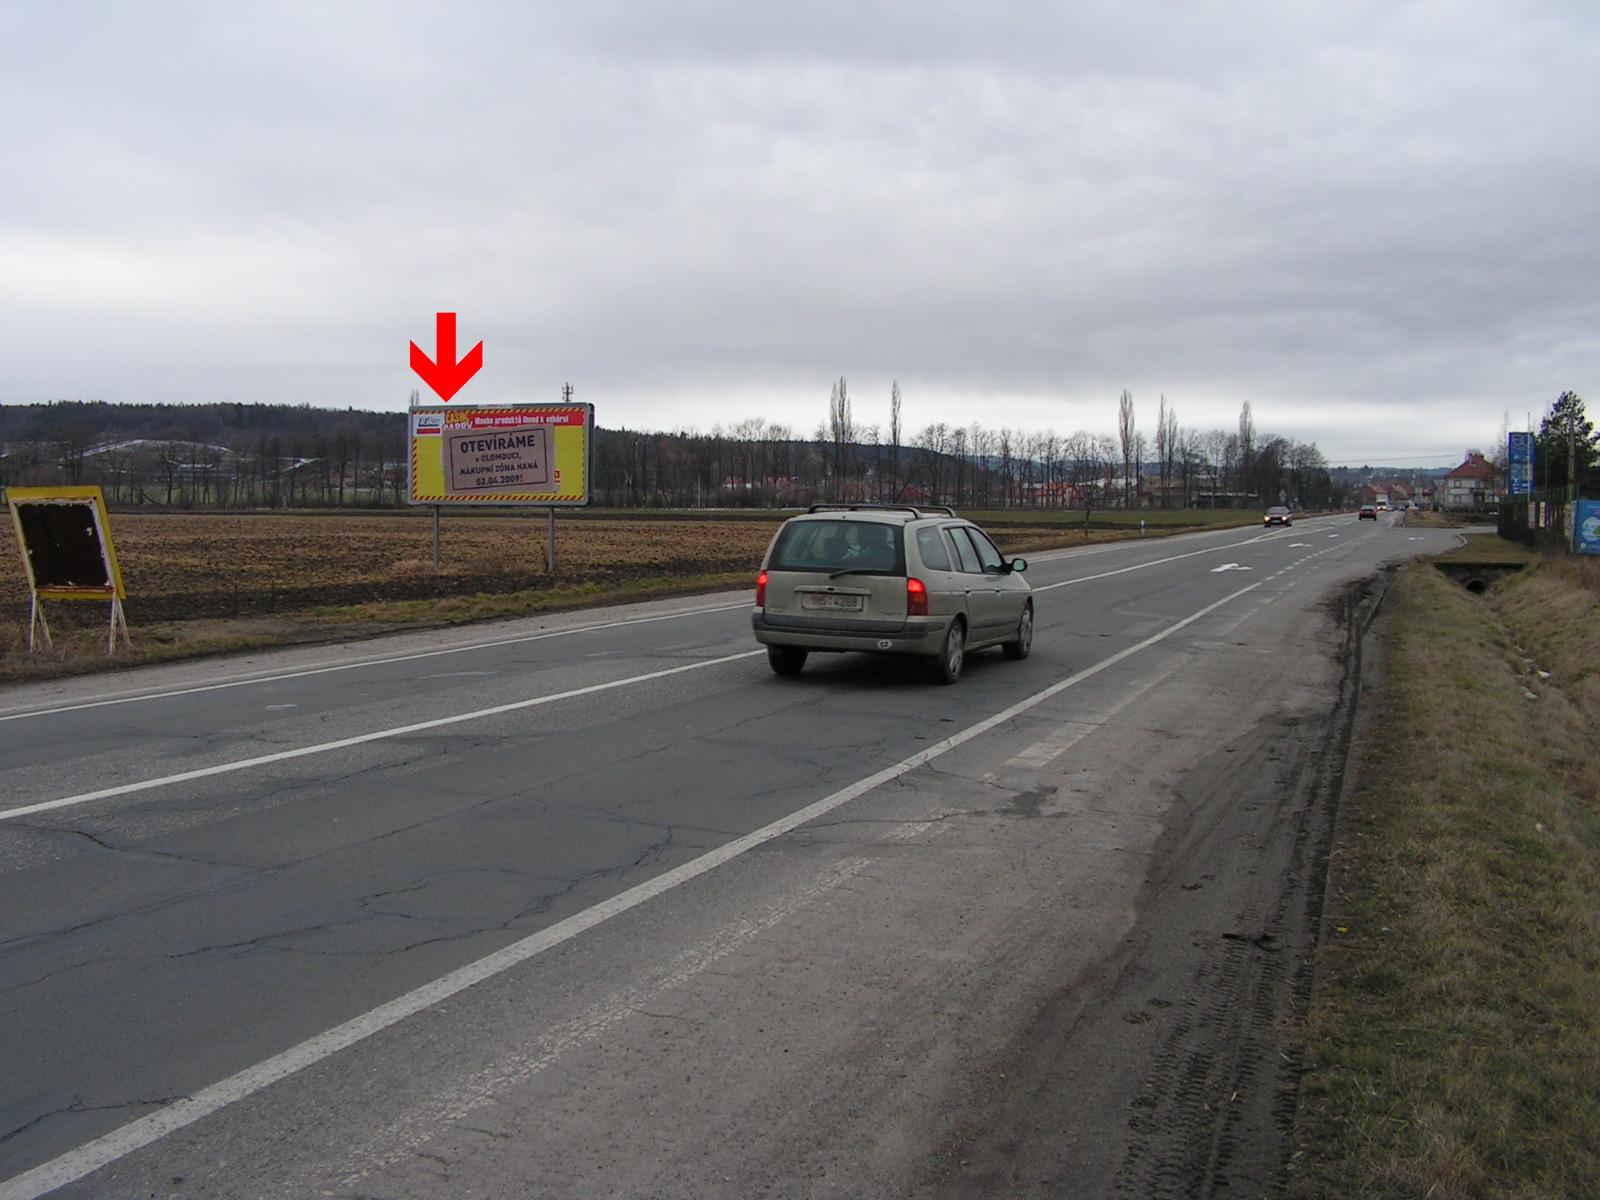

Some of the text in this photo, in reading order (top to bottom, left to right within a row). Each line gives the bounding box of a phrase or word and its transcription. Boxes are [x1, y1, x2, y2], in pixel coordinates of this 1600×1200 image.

[460, 432, 536, 454] OTEVÍRÁME
[480, 452, 522, 463] OLOMOUCI,
[495, 462, 516, 473] ZÓNA
[516, 459, 539, 470] HANÁ
[476, 474, 524, 486] 02.04.2009!
